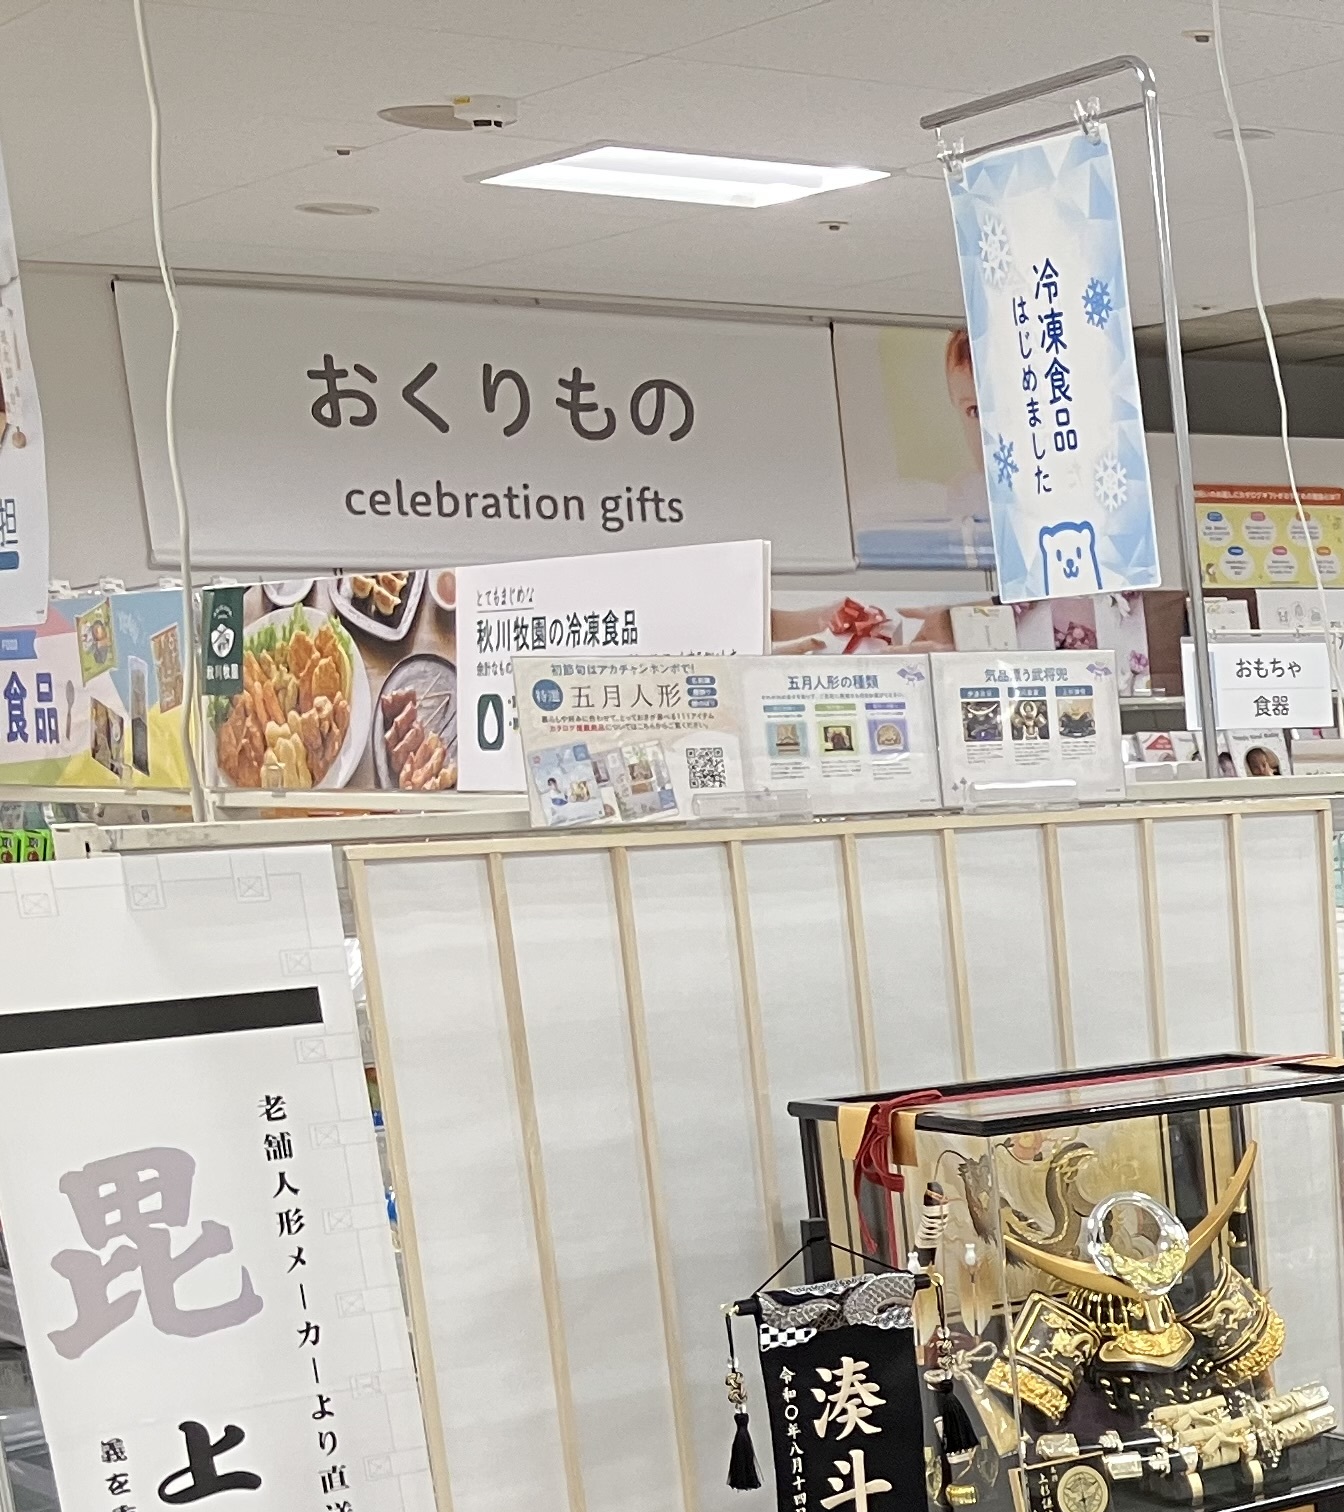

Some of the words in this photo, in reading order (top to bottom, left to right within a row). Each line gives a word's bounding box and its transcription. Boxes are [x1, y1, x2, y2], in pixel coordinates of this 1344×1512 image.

[1032, 258, 1079, 453] 冷凍食品
[305, 352, 697, 443] おくりもの
[1012, 296, 1053, 496] はじめました
[344, 479, 586, 522] celebration
[600, 484, 685, 533] gifts
[476, 586, 535, 607] とてもまじめな
[476, 609, 638, 653] 秋川牧園の冷凍食品
[1235, 657, 1302, 679] おもちゃ
[3, 671, 60, 744] 食品
[569, 682, 682, 710] 五月人形
[1253, 694, 1290, 718] 食器
